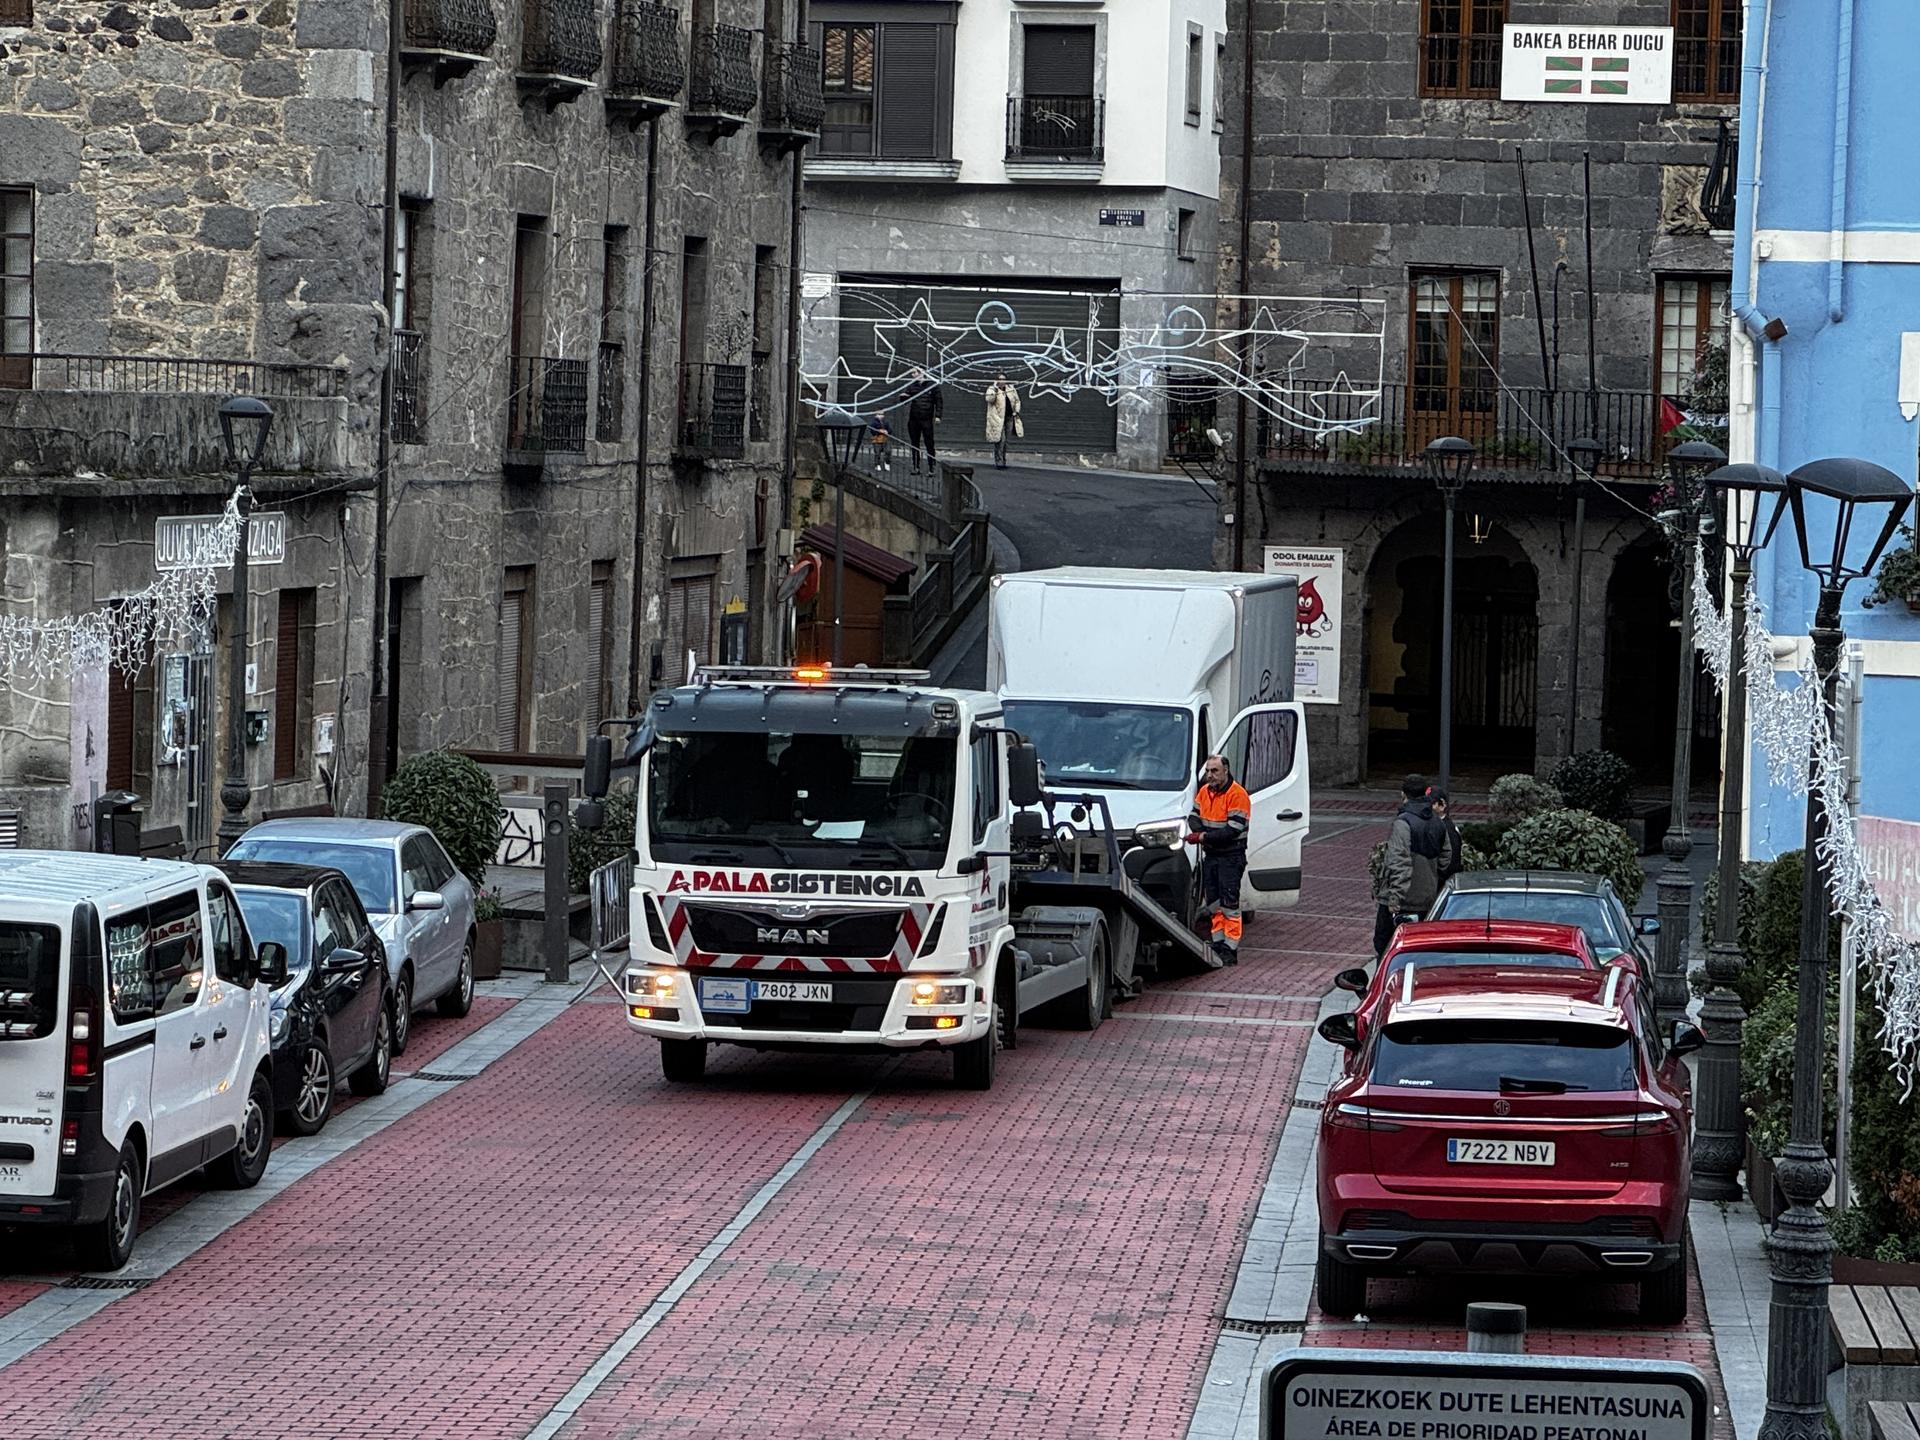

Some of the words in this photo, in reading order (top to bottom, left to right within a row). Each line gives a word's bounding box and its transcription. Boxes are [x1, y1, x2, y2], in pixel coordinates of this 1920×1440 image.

[1513, 32, 1562, 49] BAKEA
[1568, 33, 1617, 50] BEHAR
[1623, 34, 1664, 51] DUGU
[1272, 552, 1296, 561] ODOL
[1297, 553, 1335, 562] EMAILEAK
[757, 927, 829, 945] MAN
[760, 984, 797, 999] 7802
[802, 985, 829, 1000] JXN
[1460, 1142, 1507, 1161] 7222
[1514, 1145, 1549, 1163] NBV
[1293, 1387, 1432, 1411] OINEZKOEK
[1439, 1392, 1503, 1413] DUTE
[1511, 1394, 1685, 1419] LEHENTASUNA
[1325, 1416, 1382, 1437] ÁREA
[1388, 1421, 1416, 1437] DE
[1422, 1422, 1537, 1440] PRIORIDAD
